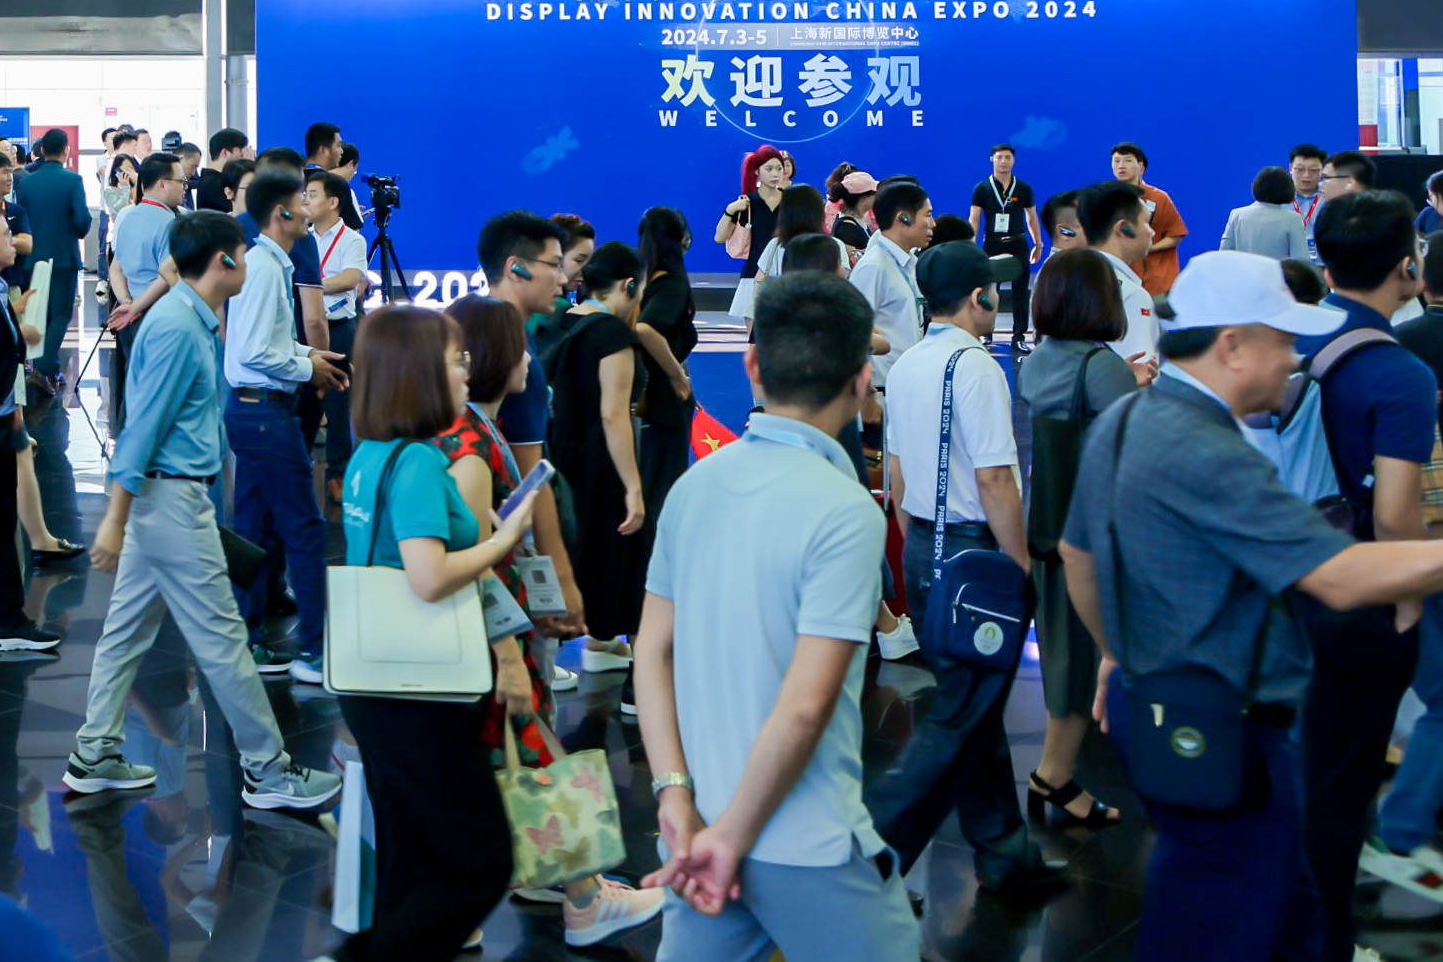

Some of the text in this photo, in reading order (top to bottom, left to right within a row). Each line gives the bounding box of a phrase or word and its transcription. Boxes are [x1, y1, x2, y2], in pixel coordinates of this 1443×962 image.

[486, 0, 1097, 21] DISPLAY INNOVATION CHINA EXPO 2024
[661, 28, 767, 46] 2024.7.3-5
[790, 26, 918, 40] 上海新国际博览中心
[661, 53, 922, 108] 欢迎参观
[659, 110, 924, 127] WELCOME
[942, 380, 952, 434] PARIS 2024
[938, 443, 948, 496] PARIS 2024
[936, 505, 945, 531] PARIS
[935, 534, 943, 560] 2024
